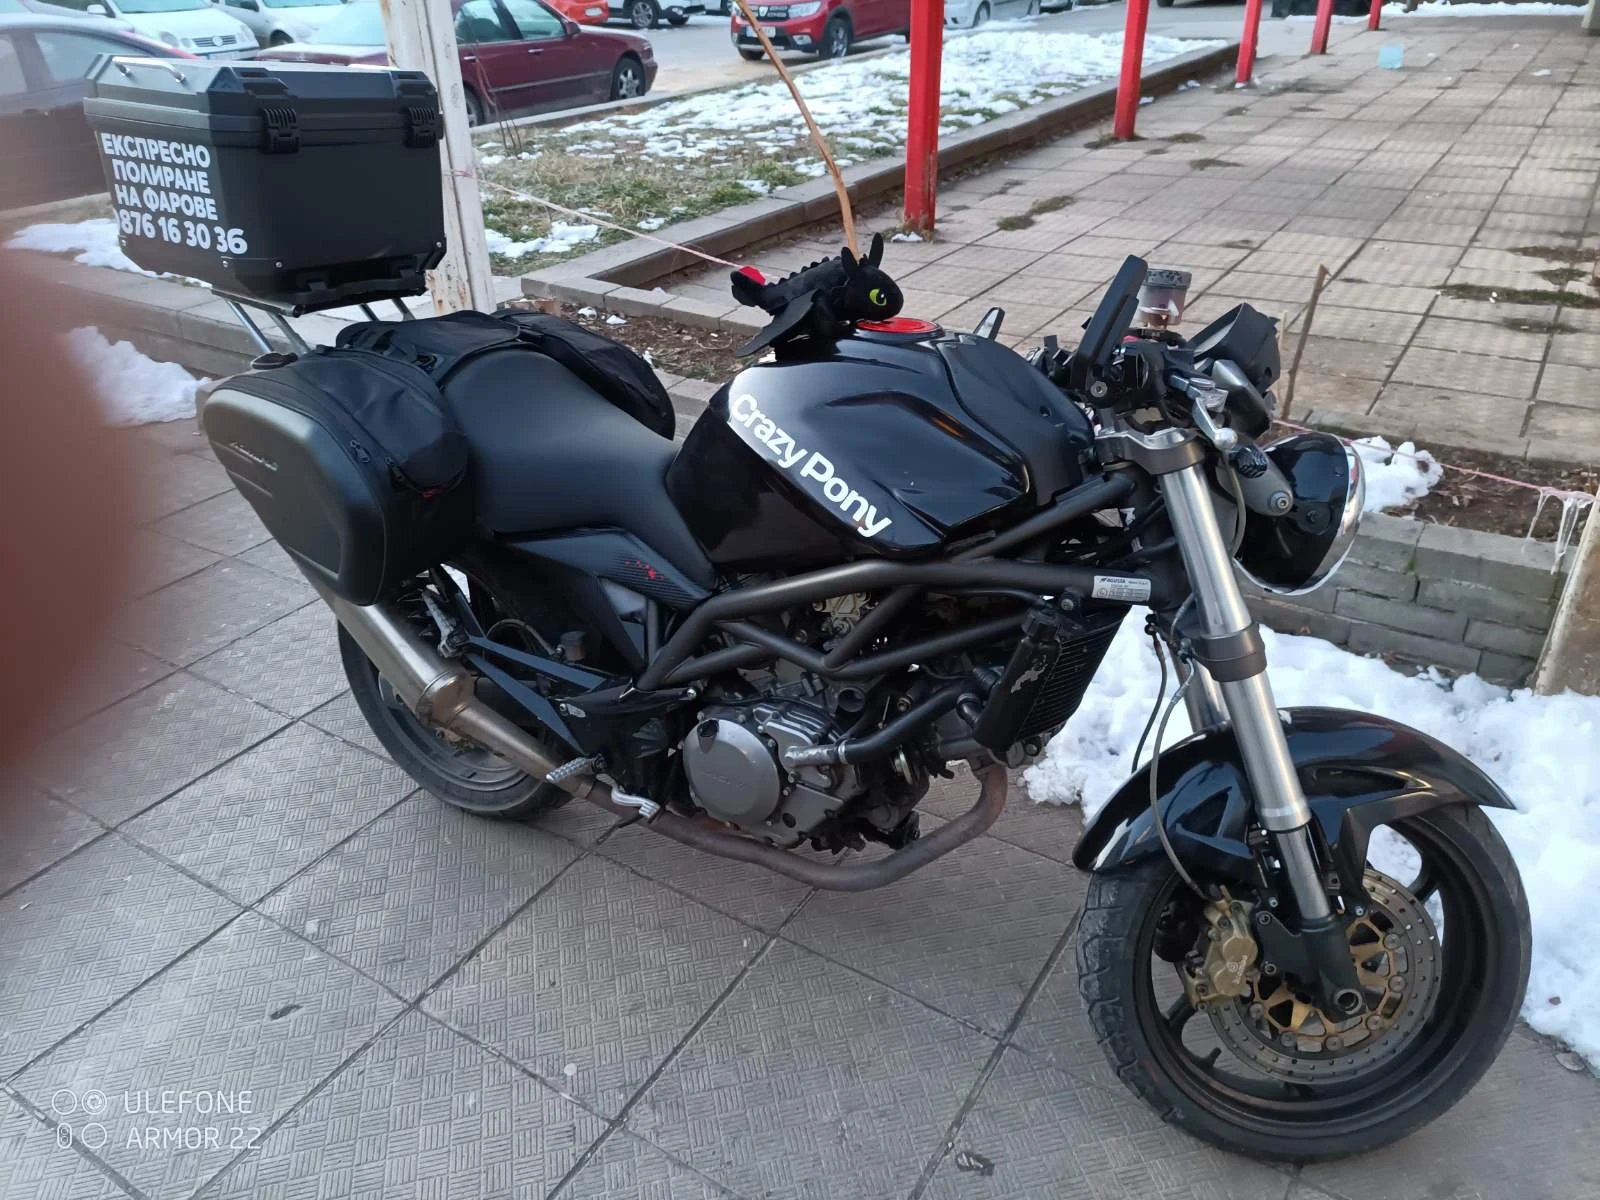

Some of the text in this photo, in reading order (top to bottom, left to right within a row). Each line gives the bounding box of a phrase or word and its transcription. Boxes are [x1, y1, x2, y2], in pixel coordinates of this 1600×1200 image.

[100, 132, 211, 168] ЕКСПРЕСНО
[111, 158, 211, 194] ПОЛИРАНЕ
[114, 183, 219, 221] НА ФАРОВЕ
[113, 206, 248, 255] 876 16 30 36
[731, 393, 893, 537] Crazy Pony
